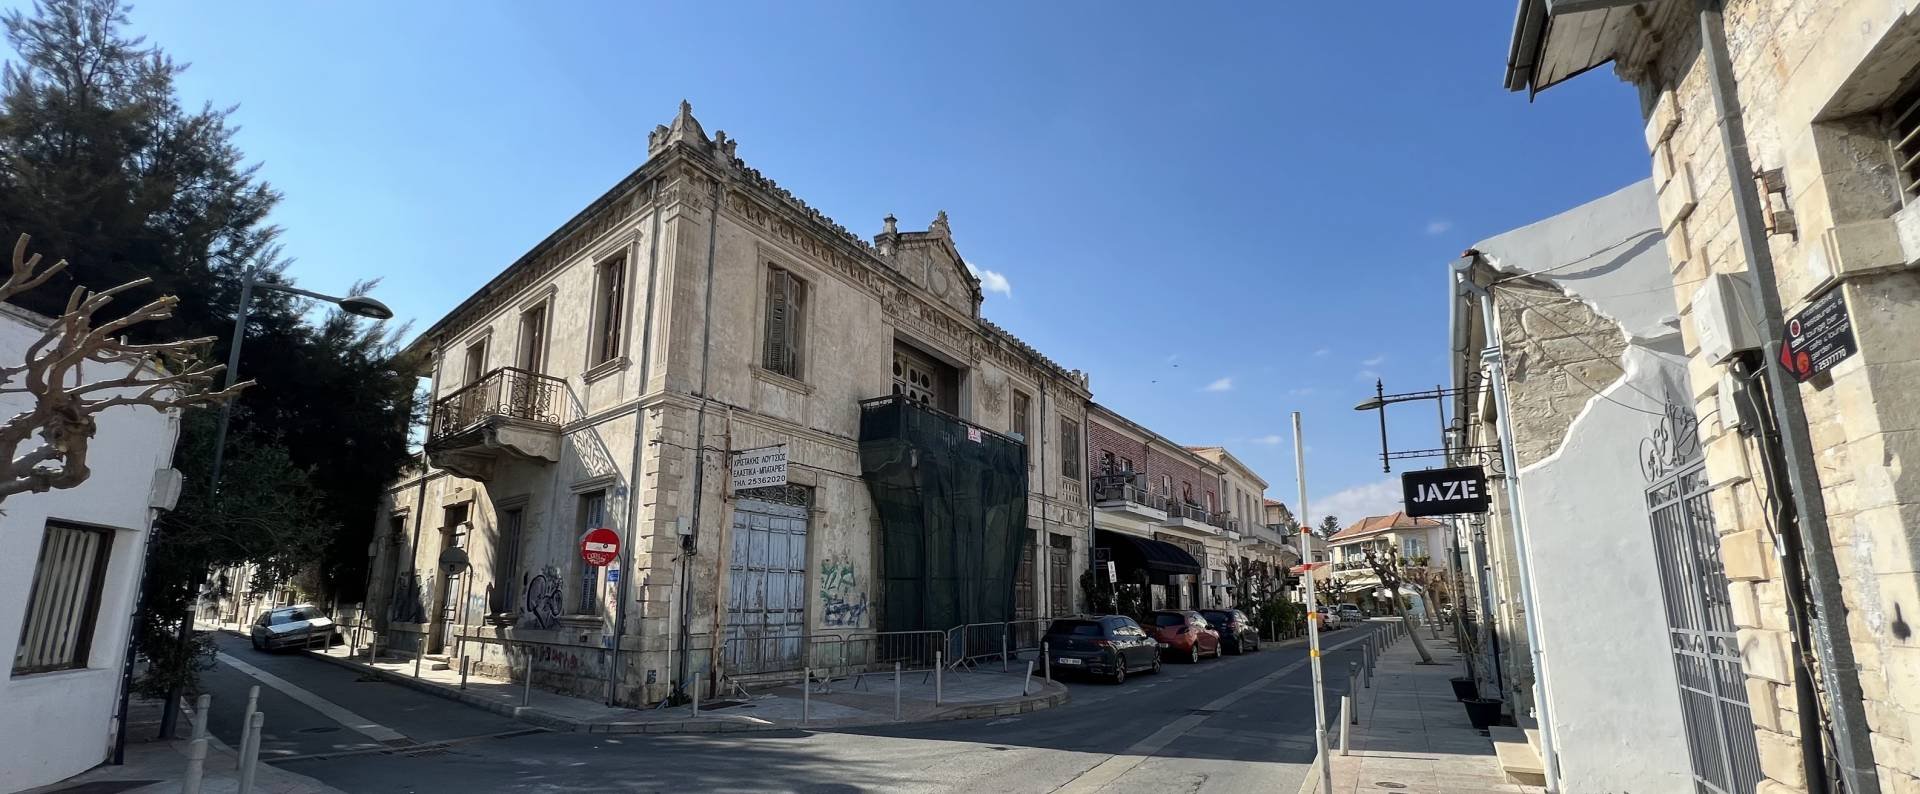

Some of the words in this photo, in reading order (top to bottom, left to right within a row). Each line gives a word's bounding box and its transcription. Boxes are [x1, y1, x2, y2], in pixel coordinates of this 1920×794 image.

[1804, 303, 1836, 328] restaurant
[1806, 321, 1826, 338] lounge
[1826, 313, 1838, 325] bar
[1828, 322, 1848, 338] lounge
[1811, 343, 1832, 360] garden
[747, 475, 786, 485] 25362020
[1412, 479, 1479, 503] JAZE
